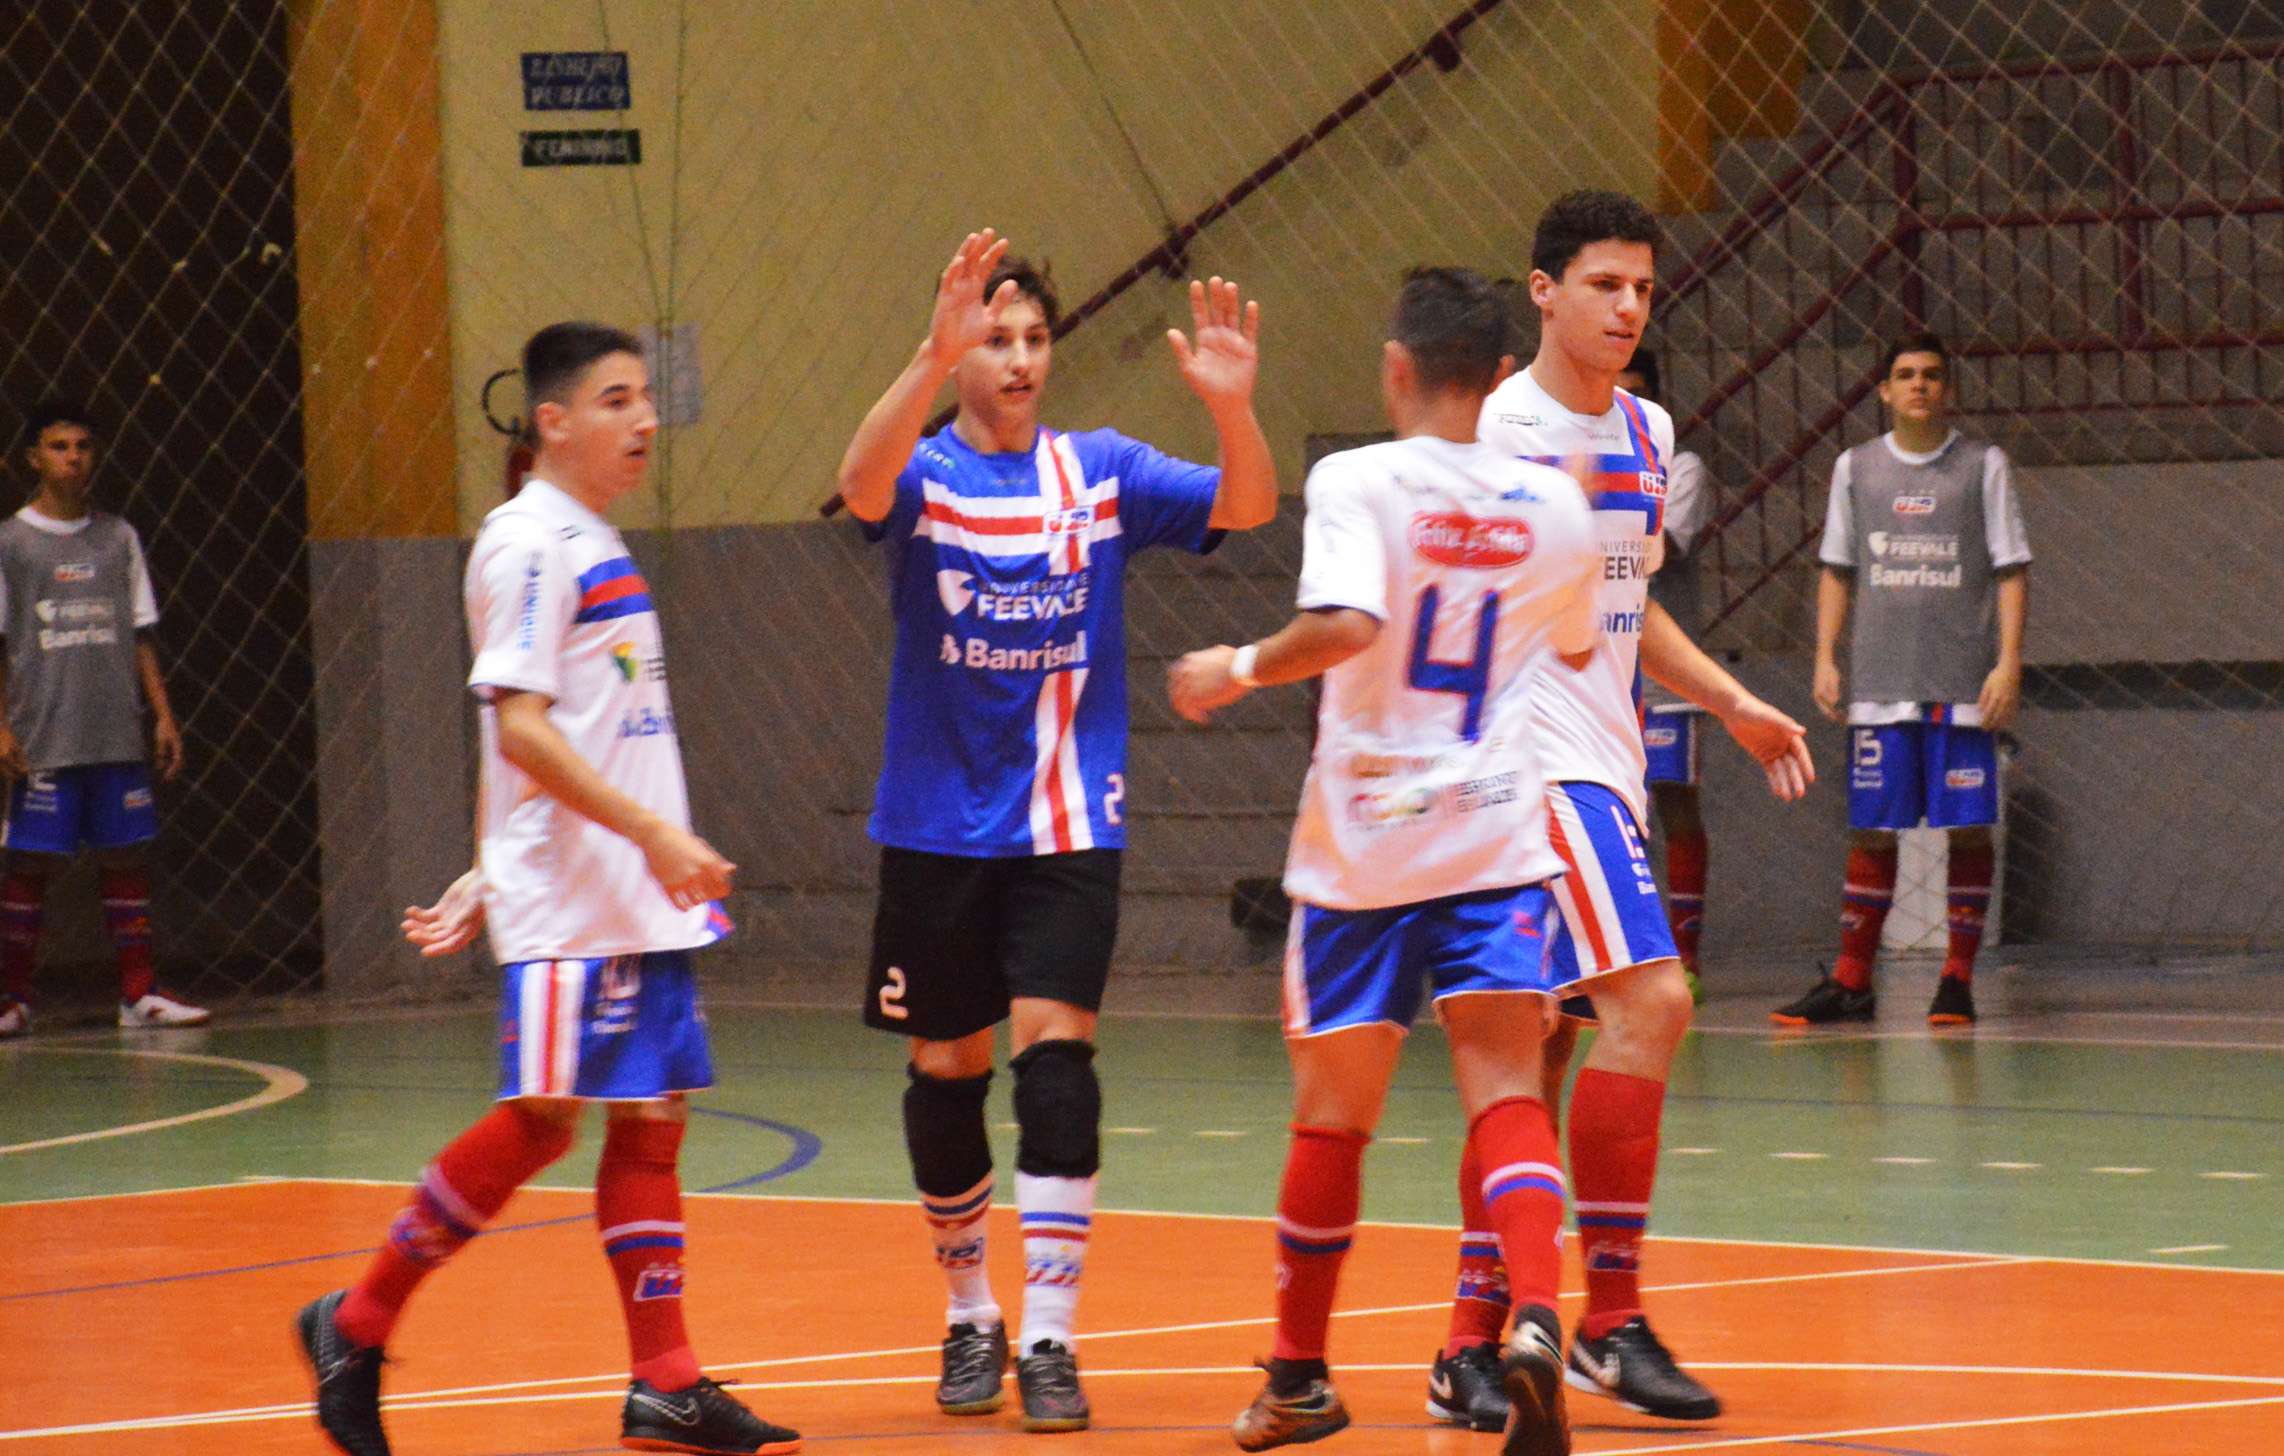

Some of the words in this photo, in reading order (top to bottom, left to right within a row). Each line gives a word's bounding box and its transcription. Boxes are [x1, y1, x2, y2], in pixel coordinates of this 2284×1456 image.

[1870, 563, 1962, 587] Banrisul
[977, 587, 1090, 621] FEEVALE
[965, 630, 1087, 670] Banrisul
[1407, 584, 1499, 743] 4
[1103, 772, 1125, 825] 2
[879, 966, 909, 1020] 2
